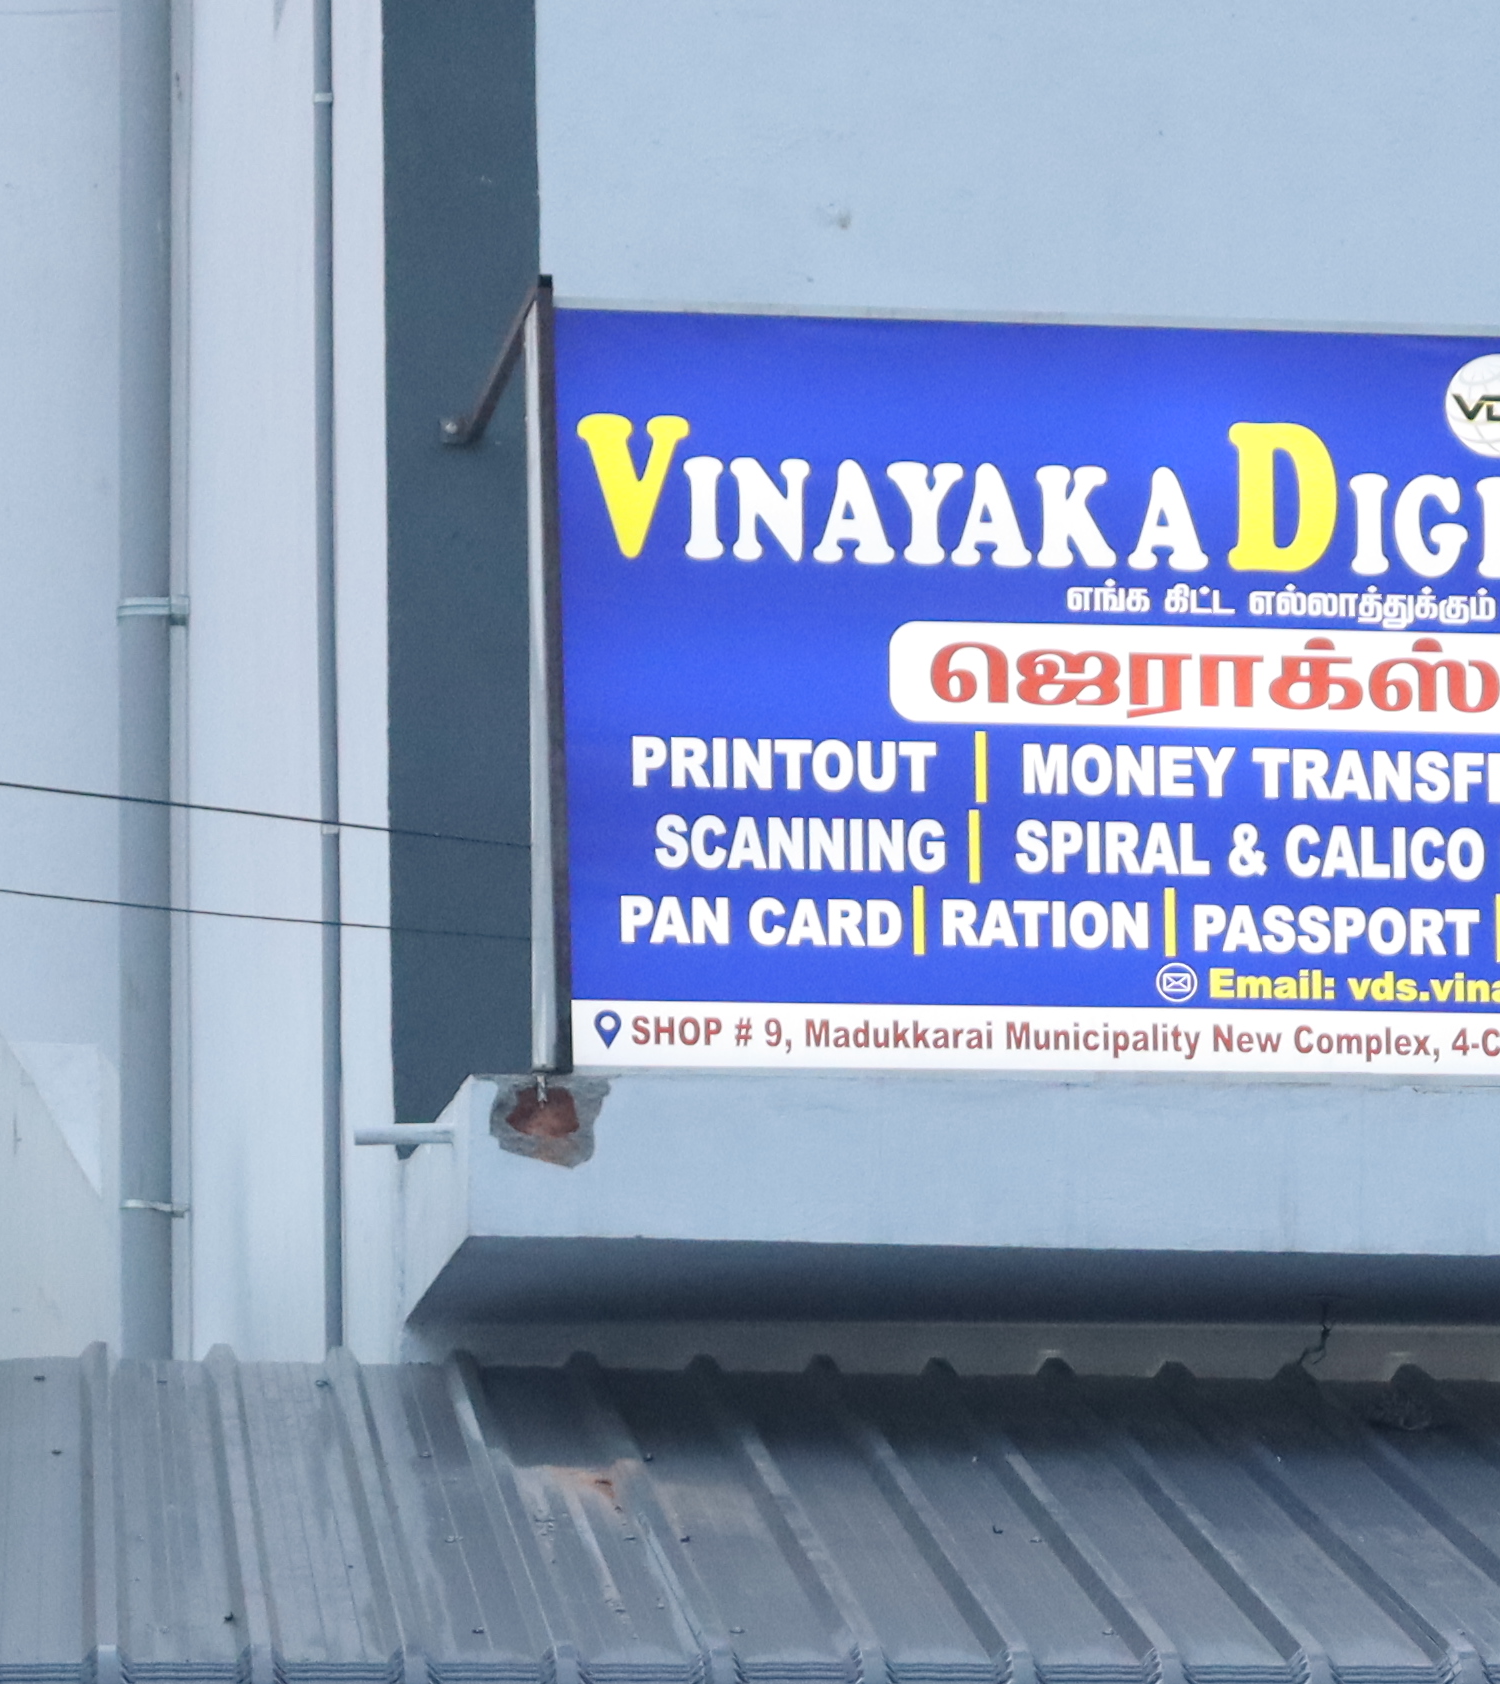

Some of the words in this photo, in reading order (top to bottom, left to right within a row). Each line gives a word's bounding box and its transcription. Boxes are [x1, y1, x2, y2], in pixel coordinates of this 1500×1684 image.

[577, 413, 1208, 570] VINAYAKA
[1067, 579, 1150, 613] எங்க
[1164, 583, 1235, 615] கிட்ட
[1248, 584, 1496, 627] எல்லாத்துக்கும்
[931, 638, 1500, 718] ஜெராக்ஸ்
[632, 736, 937, 792] PRINTOUT
[1023, 744, 1236, 798] MONEY
[655, 815, 945, 874] SCANNING
[1016, 820, 1210, 876] SPIRAL
[1228, 823, 1267, 877] &
[1285, 825, 1484, 882] CALICO
[621, 896, 729, 945] PAN
[749, 897, 902, 948] CARD
[942, 899, 1149, 950] RATION
[1194, 904, 1480, 956] PASSPORT
[1209, 968, 1334, 1000] Email:
[632, 1016, 722, 1045] SHOP
[735, 1019, 752, 1046] #
[765, 1019, 791, 1053] 9,
[806, 1020, 992, 1049] Madukkarai
[1007, 1022, 1199, 1060] Municipality
[1214, 1025, 1281, 1052] New
[1294, 1026, 1439, 1062] Complex,
